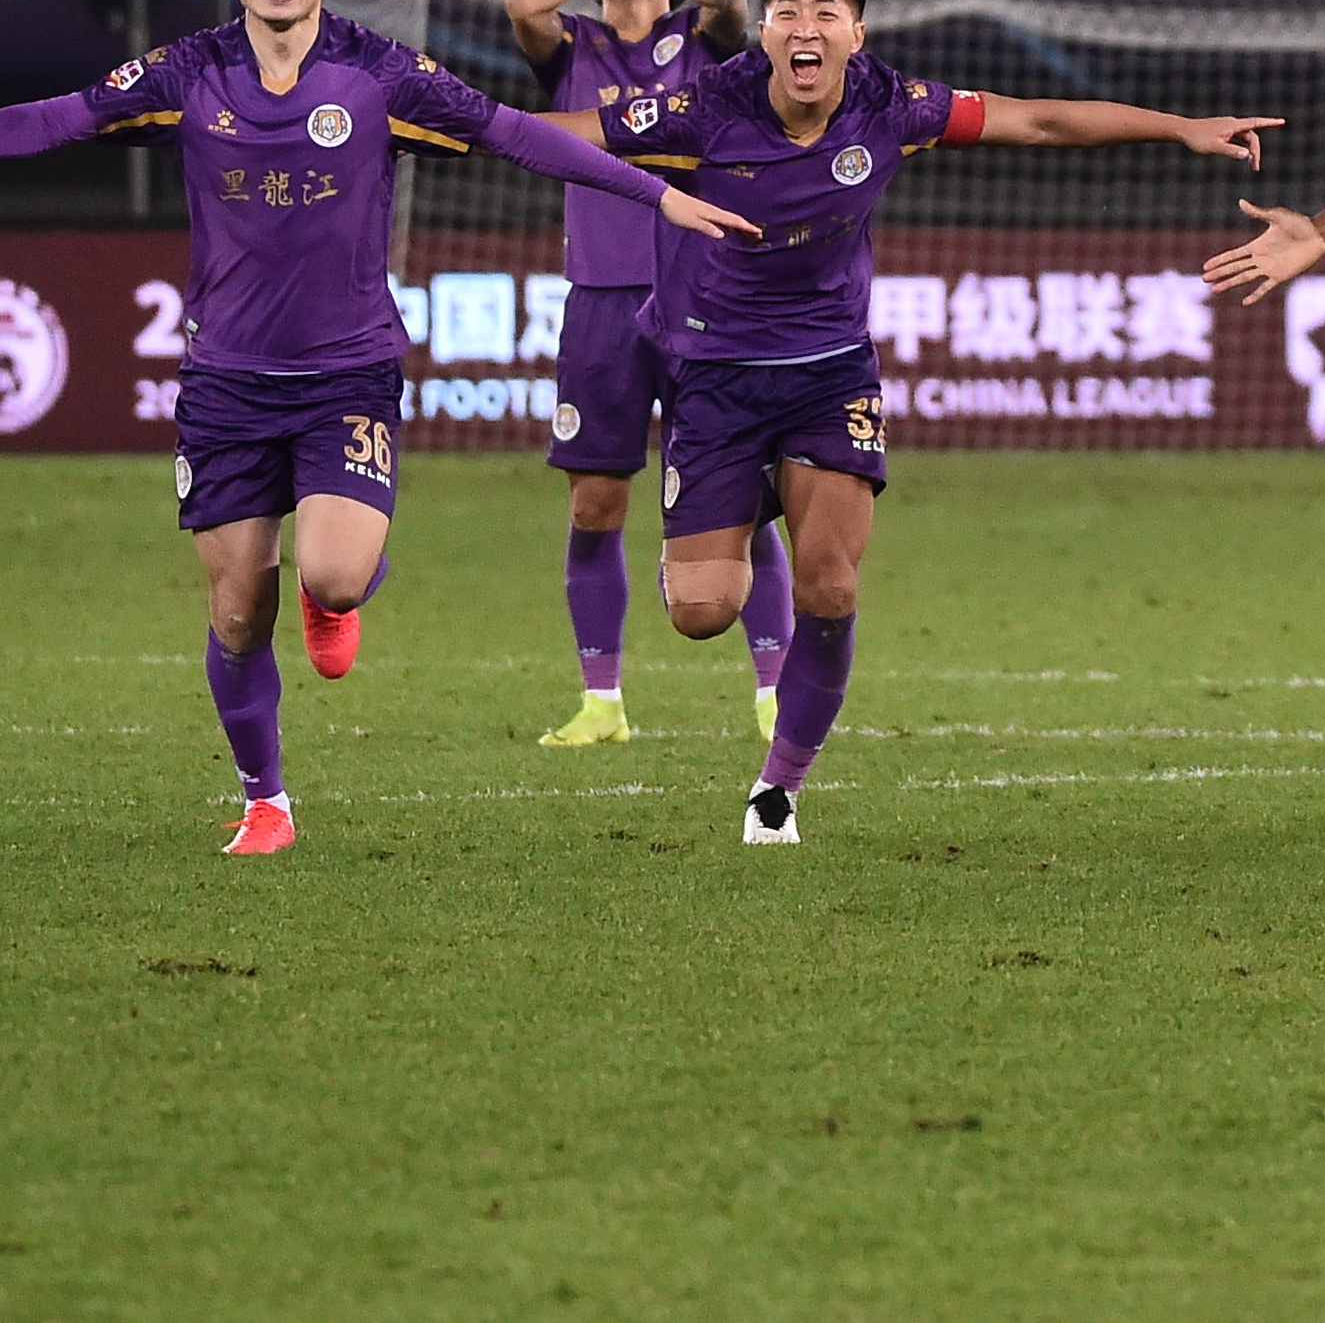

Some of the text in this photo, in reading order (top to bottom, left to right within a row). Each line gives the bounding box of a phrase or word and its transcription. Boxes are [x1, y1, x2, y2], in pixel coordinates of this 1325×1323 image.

[220, 169, 340, 207] 黑龍江
[1051, 375, 1215, 419] LEAGUE
[342, 414, 392, 475] 36
